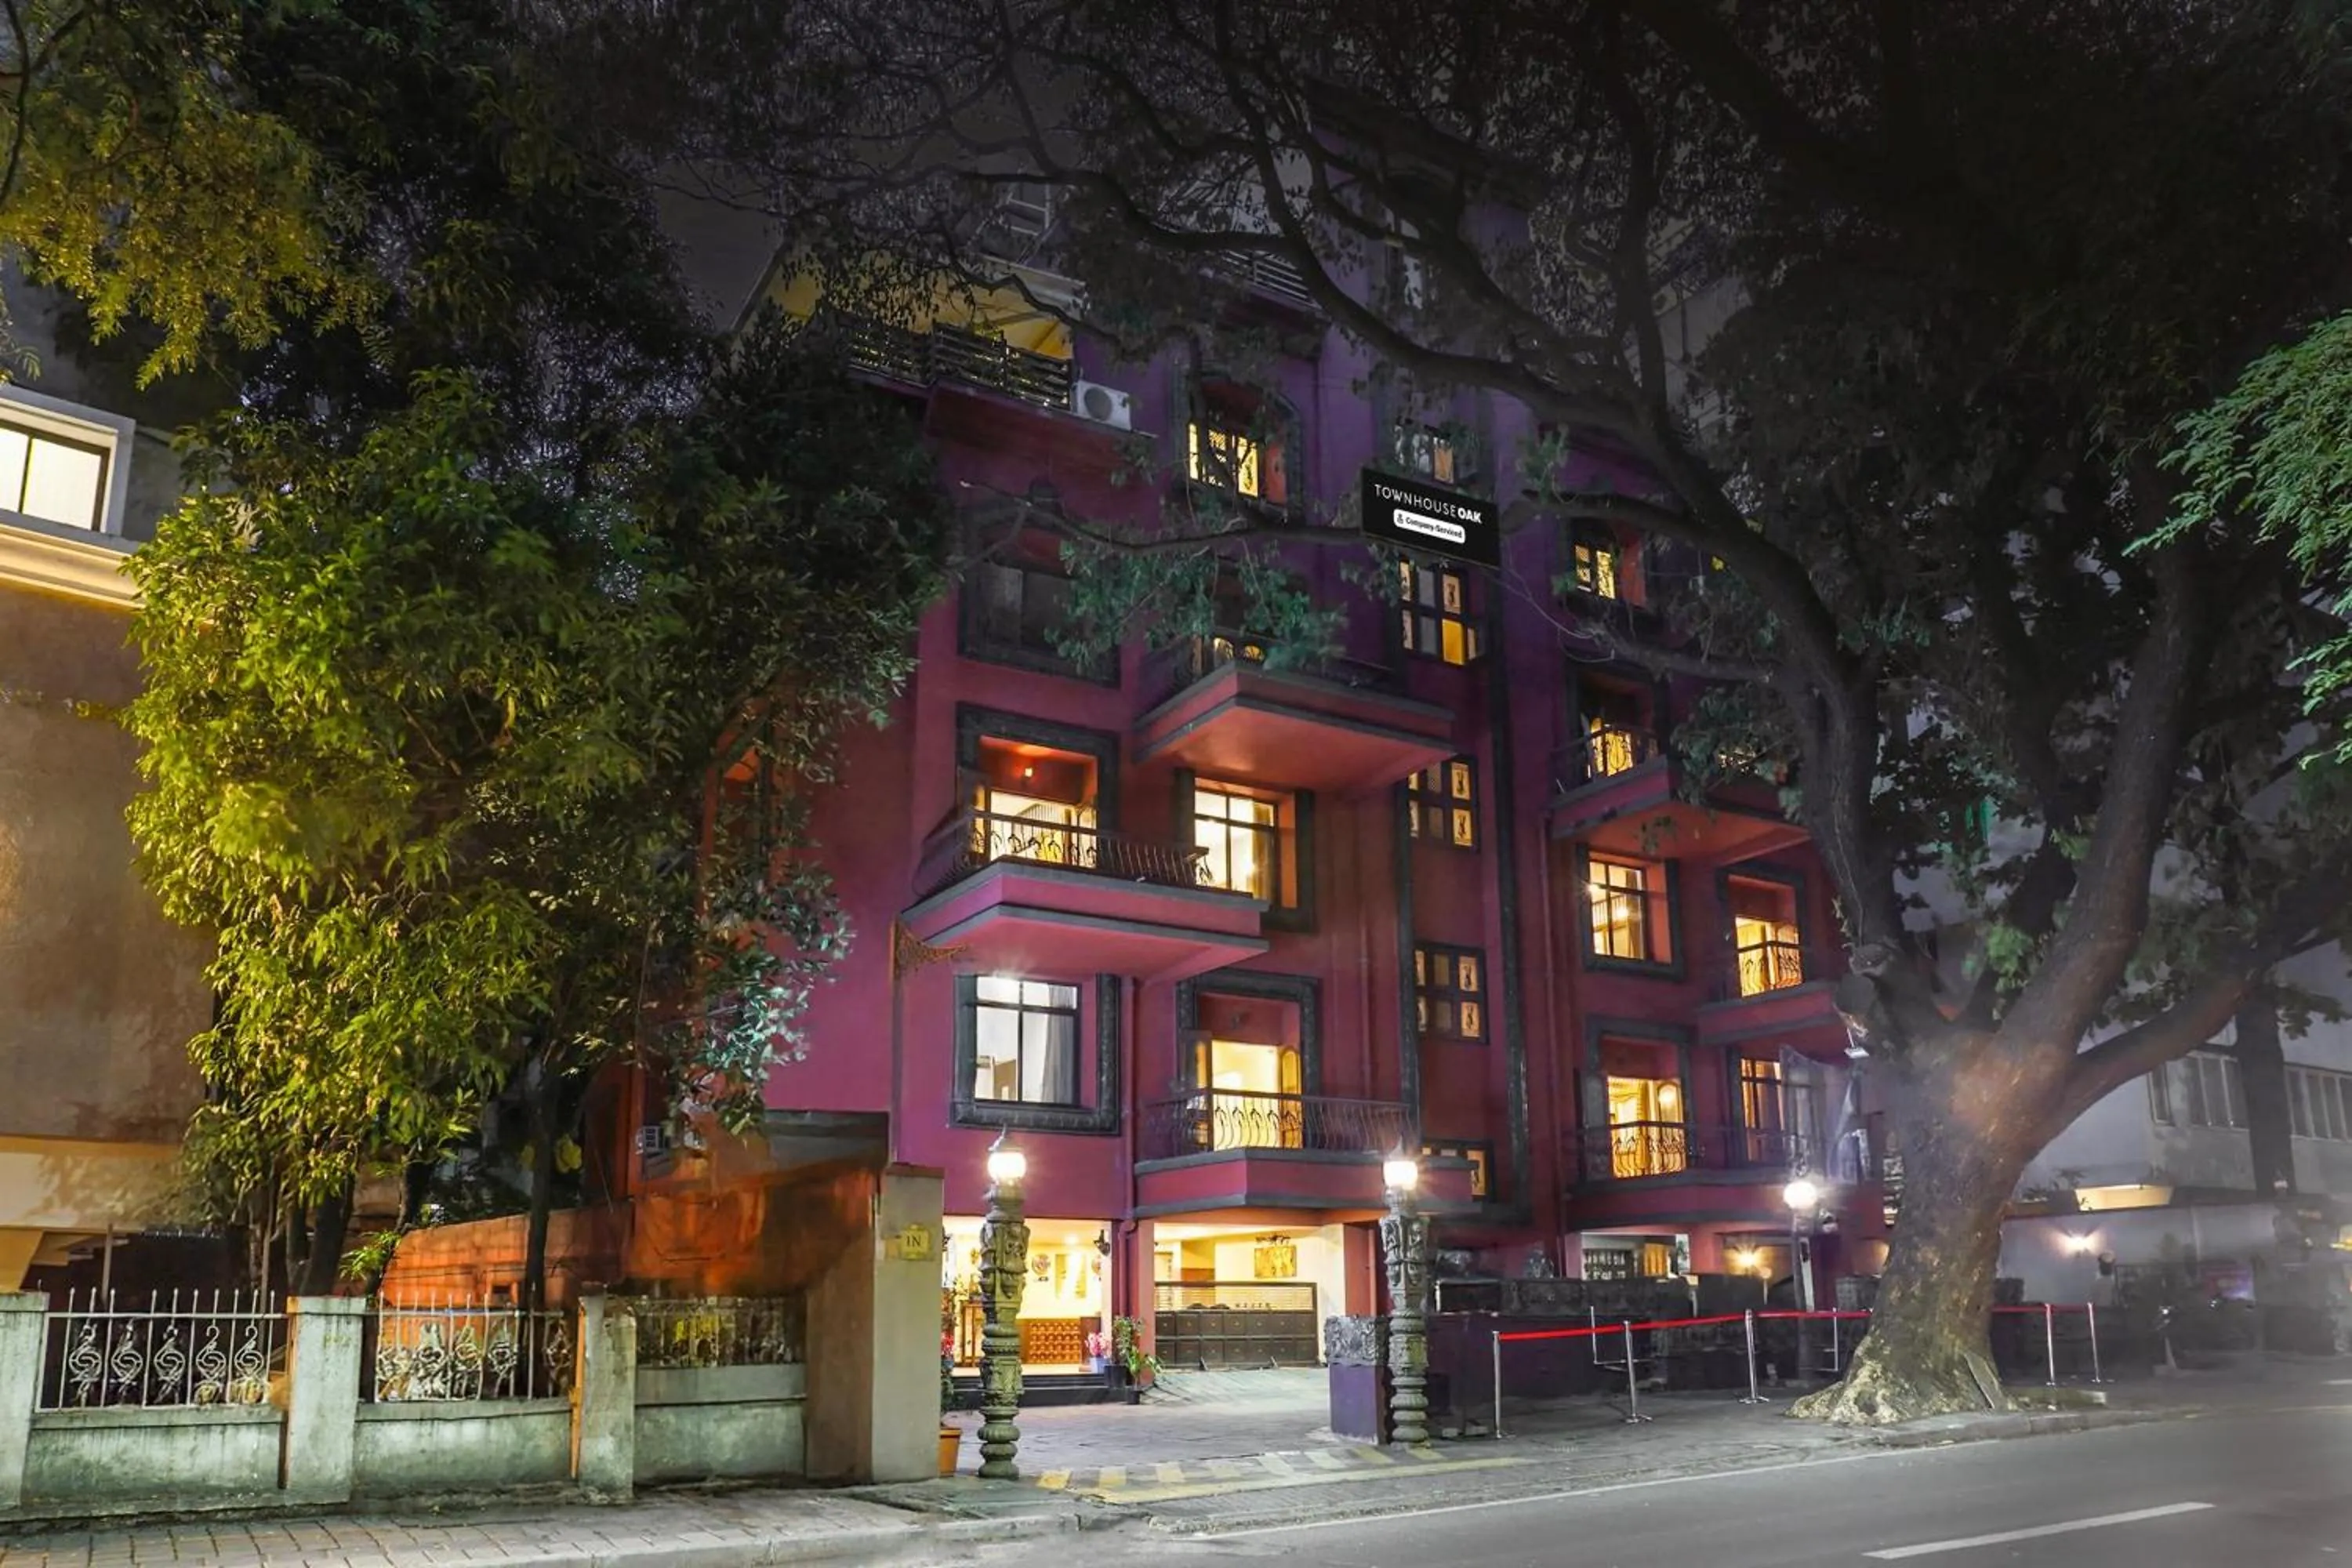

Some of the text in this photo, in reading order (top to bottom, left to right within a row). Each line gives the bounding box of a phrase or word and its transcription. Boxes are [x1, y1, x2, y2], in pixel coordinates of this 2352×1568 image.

[1374, 484, 1482, 524] TOWNHOUSE OAK
[906, 1235, 921, 1247] IN
